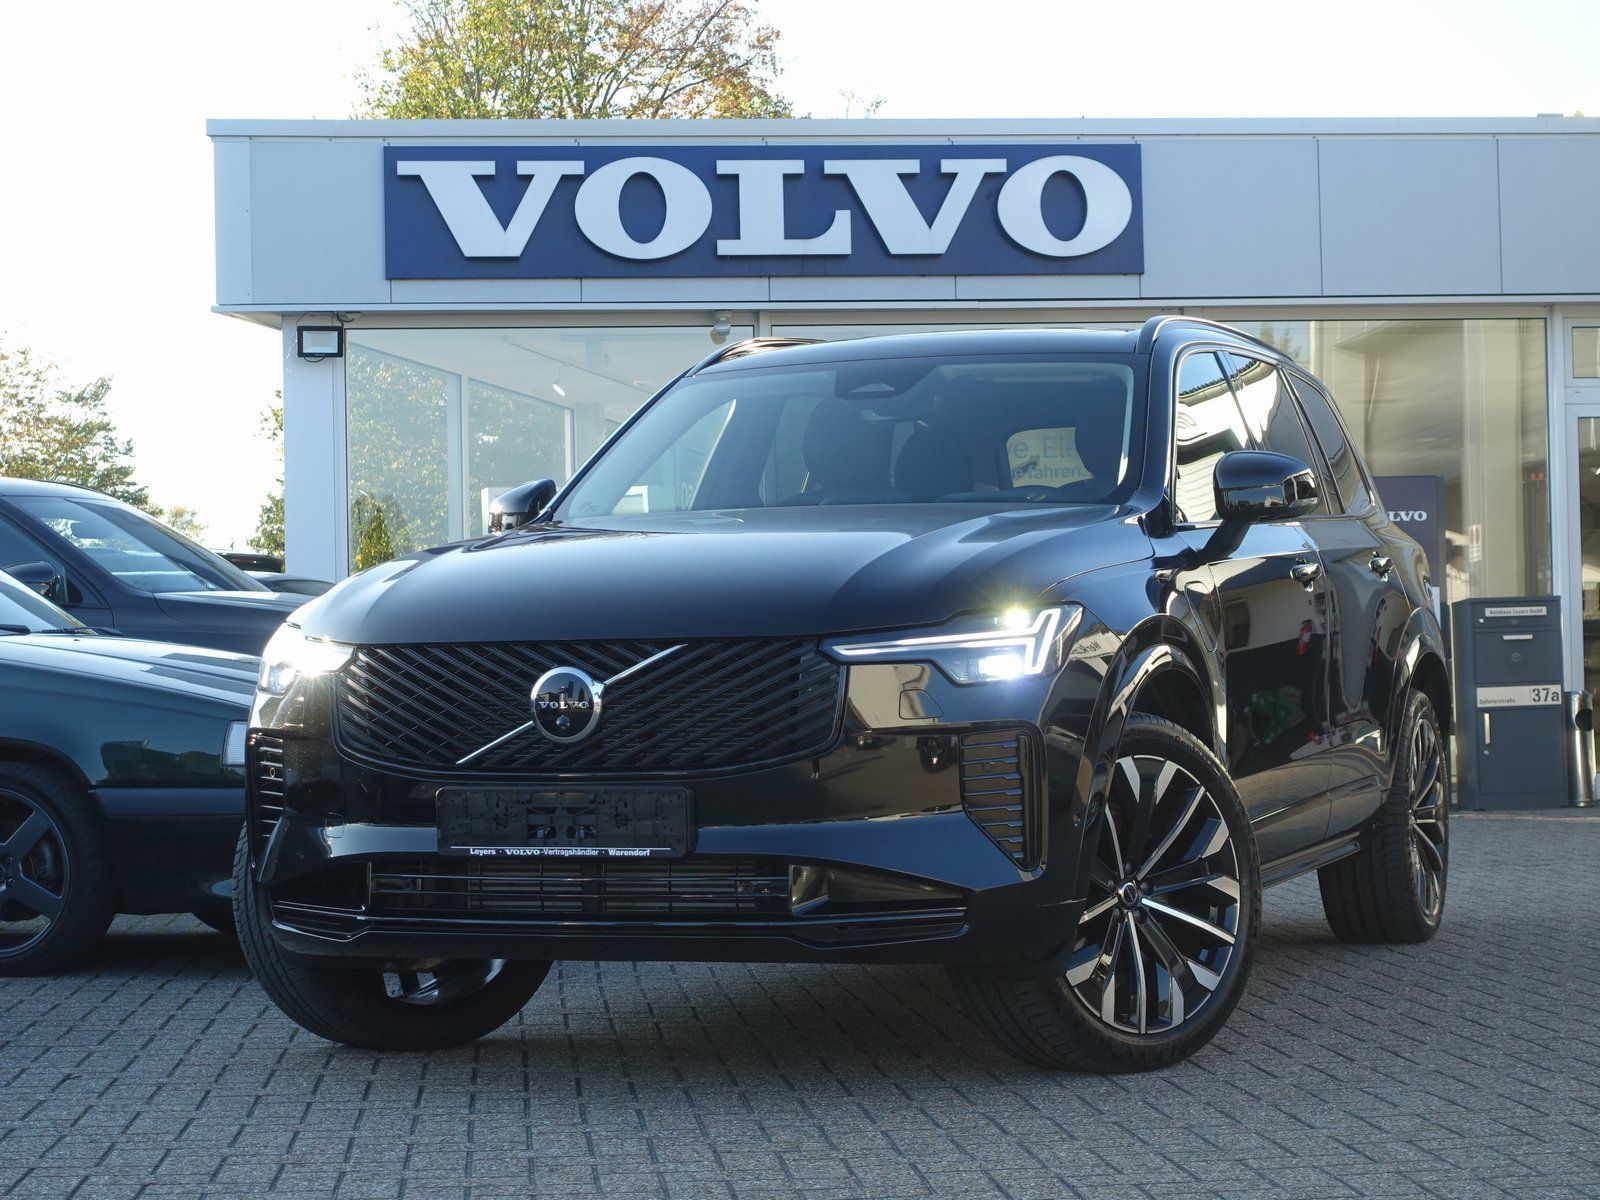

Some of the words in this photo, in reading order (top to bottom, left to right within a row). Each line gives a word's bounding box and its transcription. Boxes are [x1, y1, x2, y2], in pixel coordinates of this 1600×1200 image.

[397, 155, 1133, 260] VOLVO
[1388, 510, 1428, 522] LVO
[1532, 687, 1560, 703] 37a
[539, 701, 590, 709] VOLVO
[469, 848, 497, 857] Leyers
[608, 848, 651, 857] Warendorf
